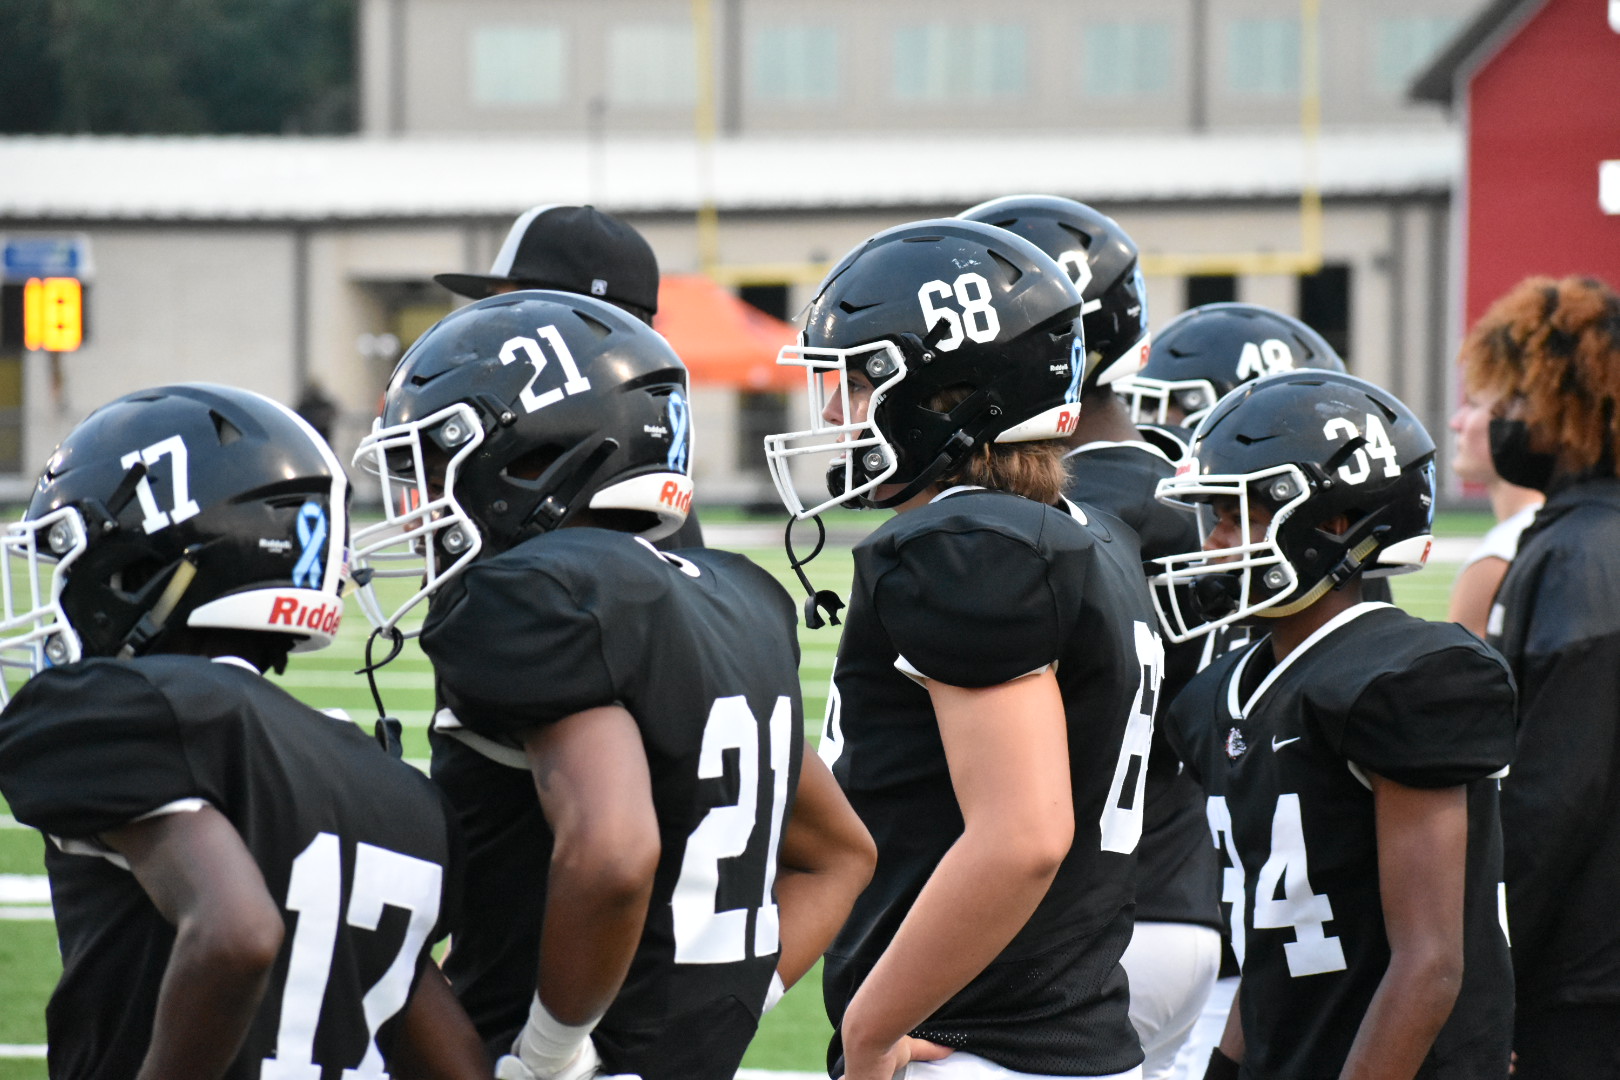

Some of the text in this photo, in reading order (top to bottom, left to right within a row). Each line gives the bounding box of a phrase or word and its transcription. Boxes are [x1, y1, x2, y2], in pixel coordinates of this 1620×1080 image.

[24, 277, 82, 352] 18
[918, 272, 1000, 352] 68
[498, 324, 591, 414] 21
[120, 434, 200, 535] 17
[1323, 413, 1401, 486] 34
[671, 694, 792, 964] 21
[260, 831, 443, 1080] 17
